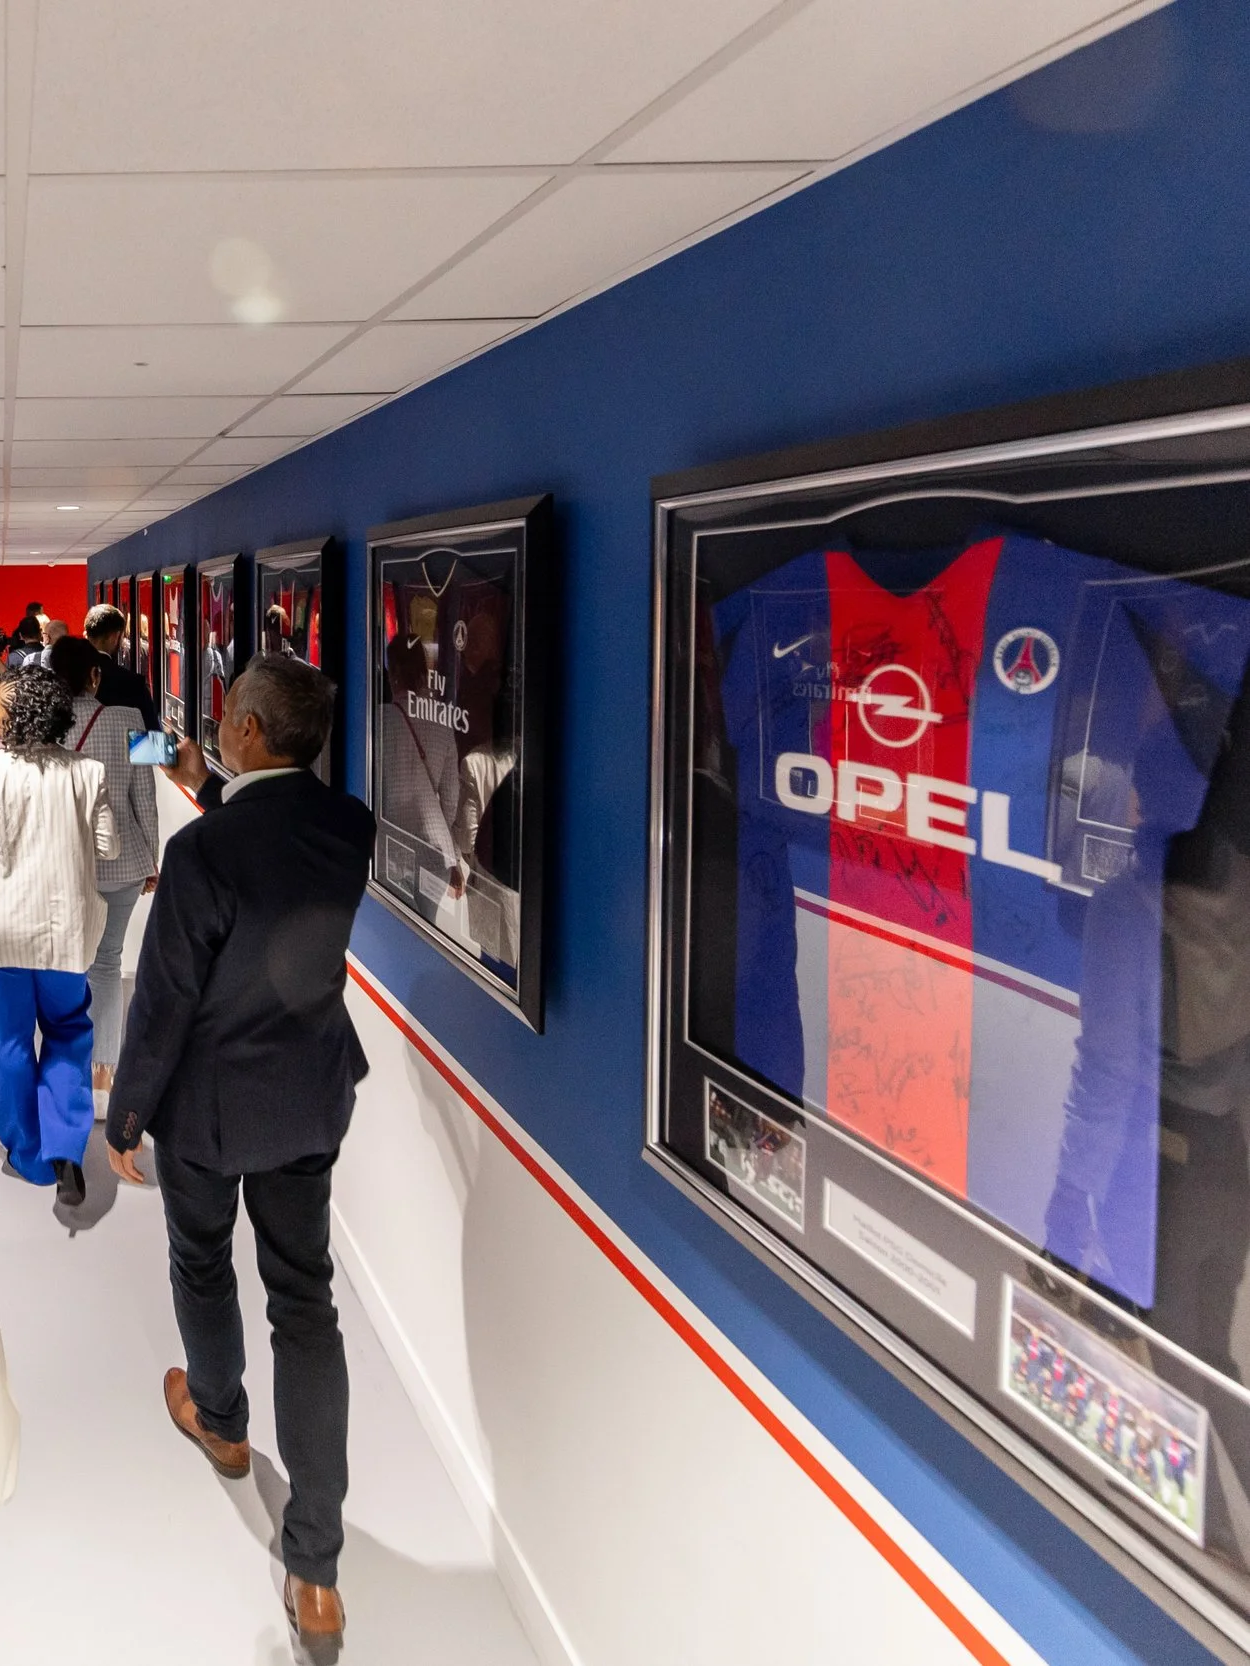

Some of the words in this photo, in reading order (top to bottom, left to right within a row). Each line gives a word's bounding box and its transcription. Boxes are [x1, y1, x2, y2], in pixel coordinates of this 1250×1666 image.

[428, 669, 446, 696] Fly
[407, 690, 469, 734] Emirates
[775, 752, 1063, 882] OPEL
